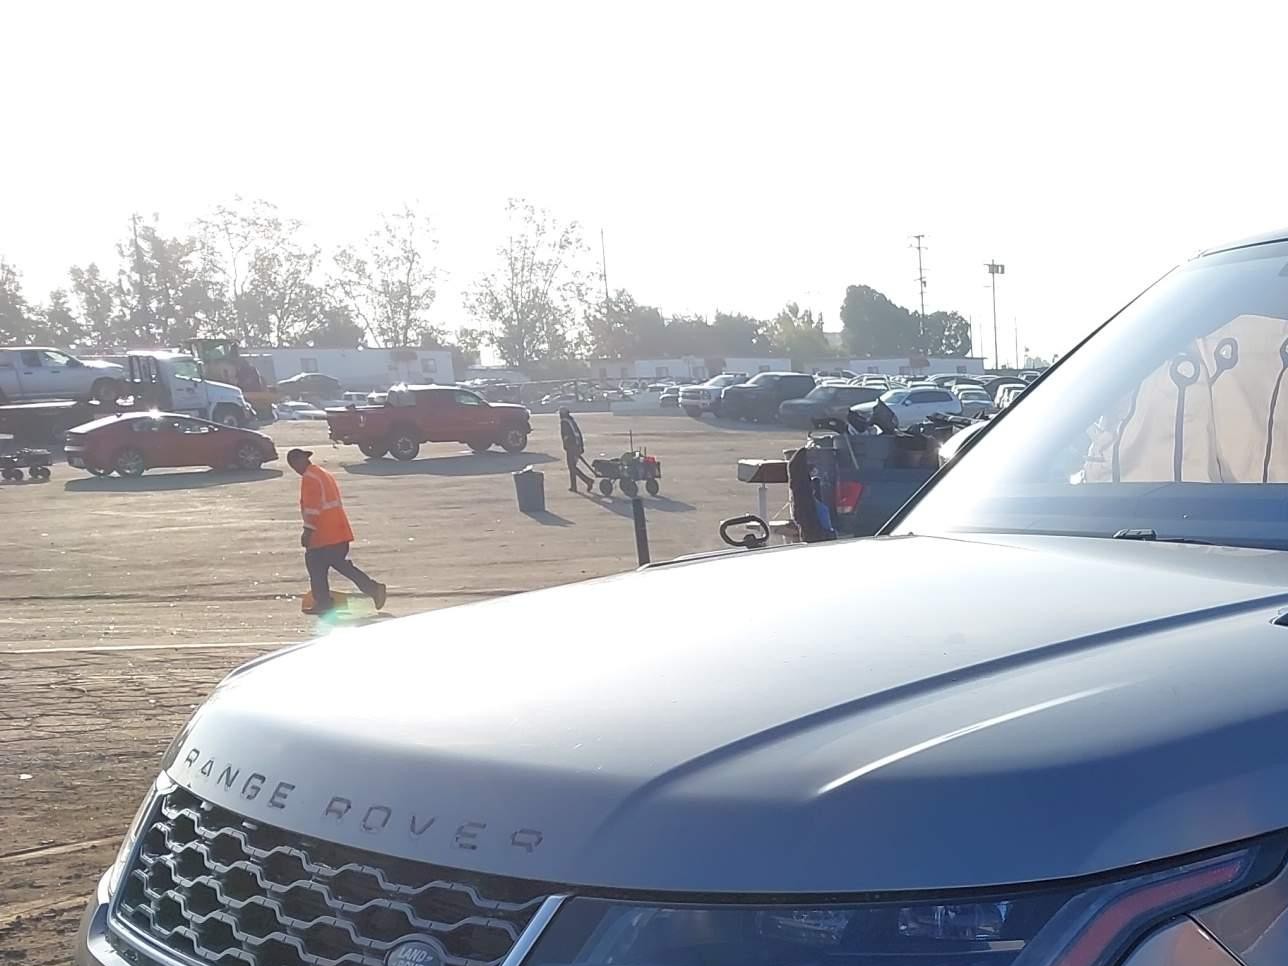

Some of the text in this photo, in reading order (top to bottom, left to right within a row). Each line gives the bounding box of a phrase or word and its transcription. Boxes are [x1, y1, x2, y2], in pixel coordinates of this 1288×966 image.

[184, 748, 545, 853] RANGE ROVER
[398, 946, 428, 962] LAND
